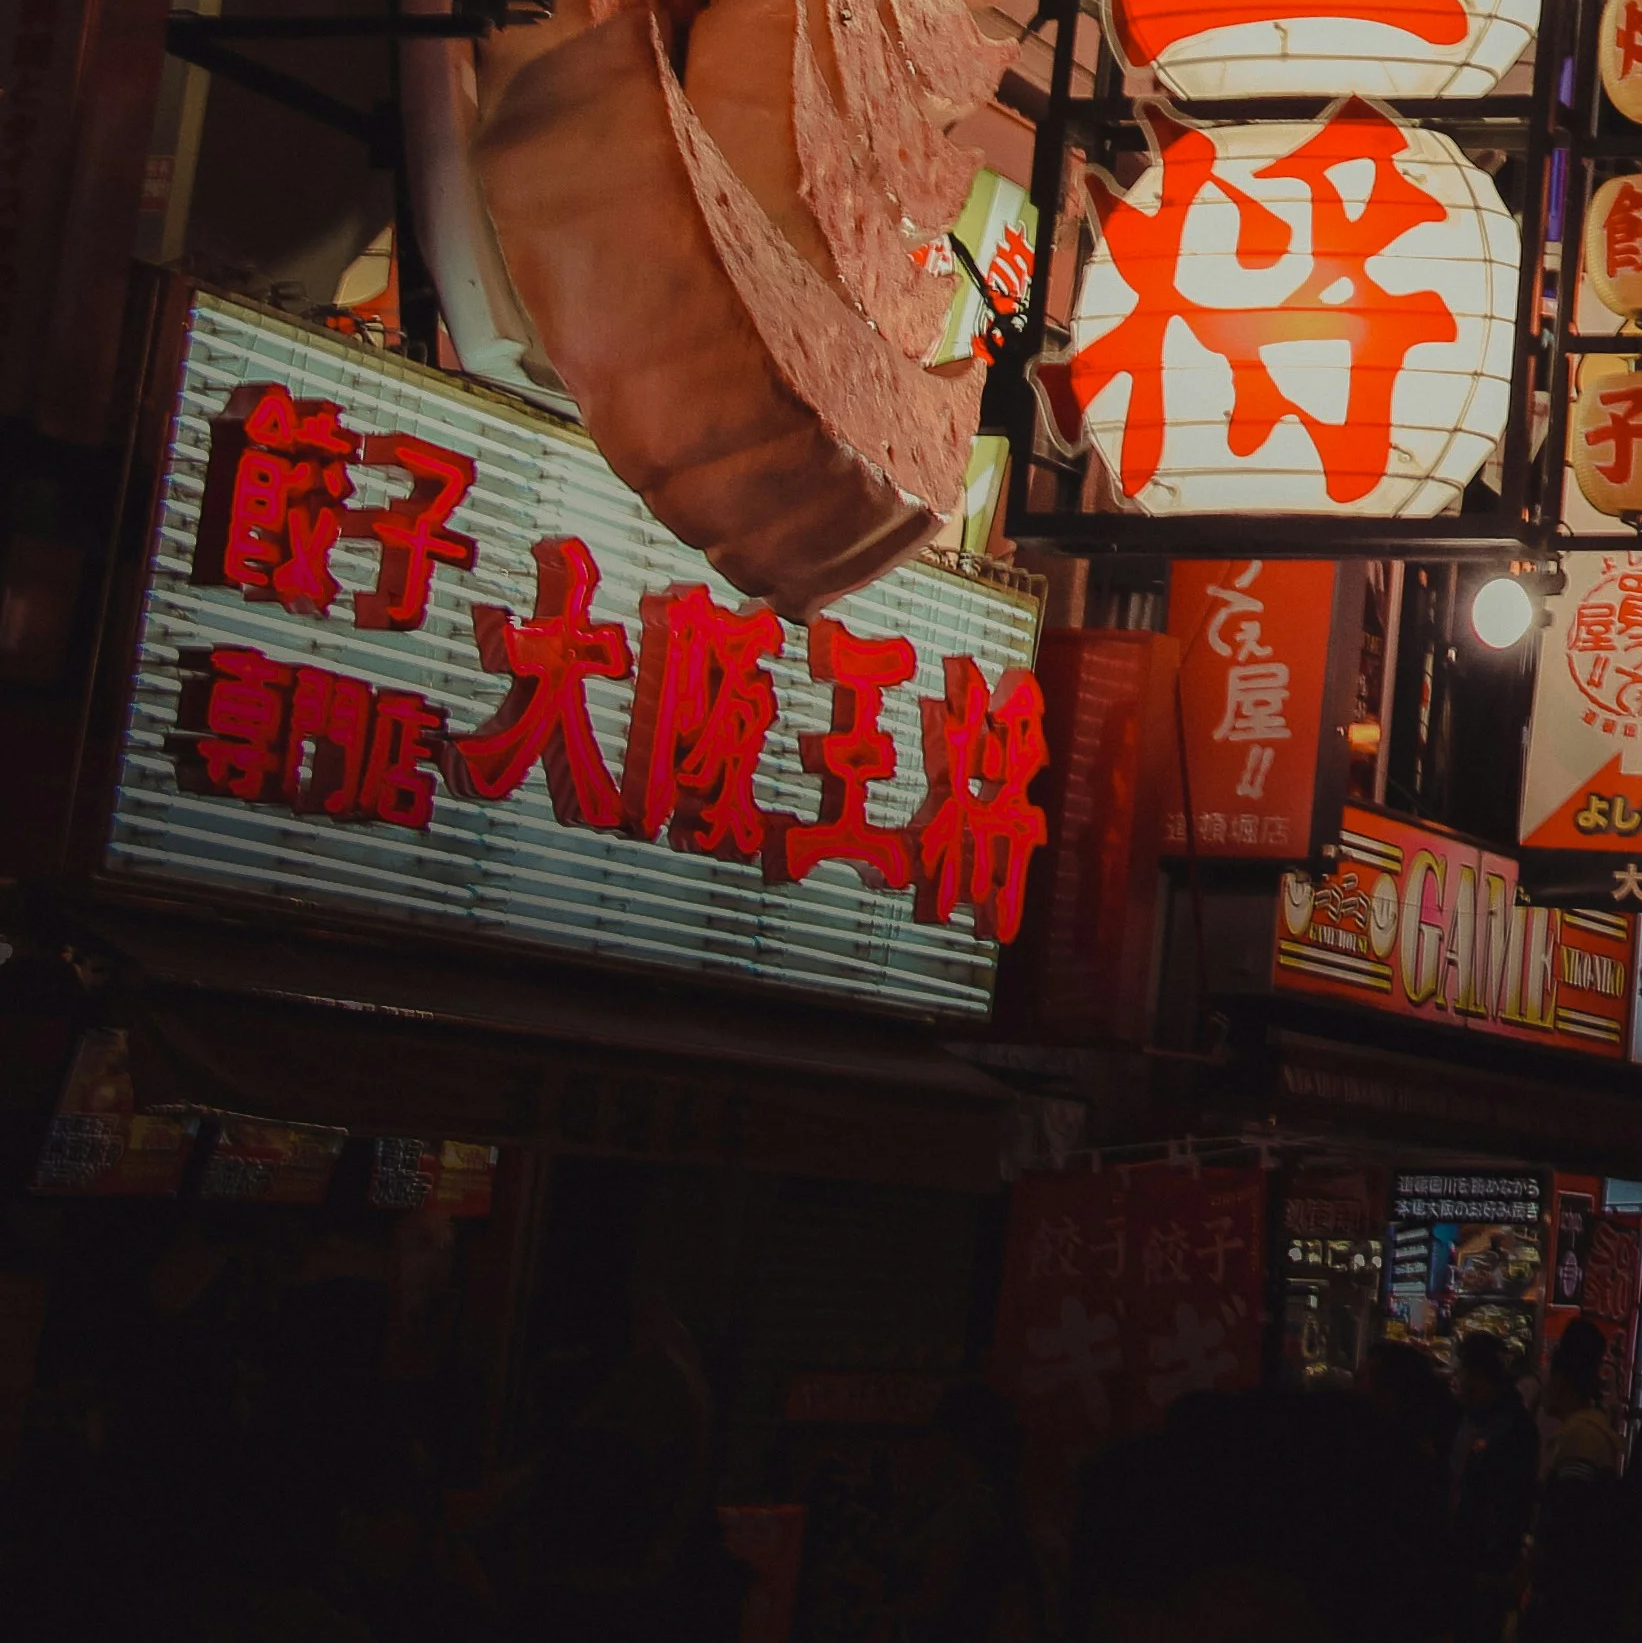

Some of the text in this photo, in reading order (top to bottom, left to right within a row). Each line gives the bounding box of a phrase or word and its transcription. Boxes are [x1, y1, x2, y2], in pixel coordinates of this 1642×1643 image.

[222, 384, 477, 623] 餃子
[199, 647, 446, 831] 専門店
[454, 538, 1049, 946] 大阪王将
[1205, 558, 1292, 800] てぇ屋!!
[1402, 849, 1562, 1031] GAME
